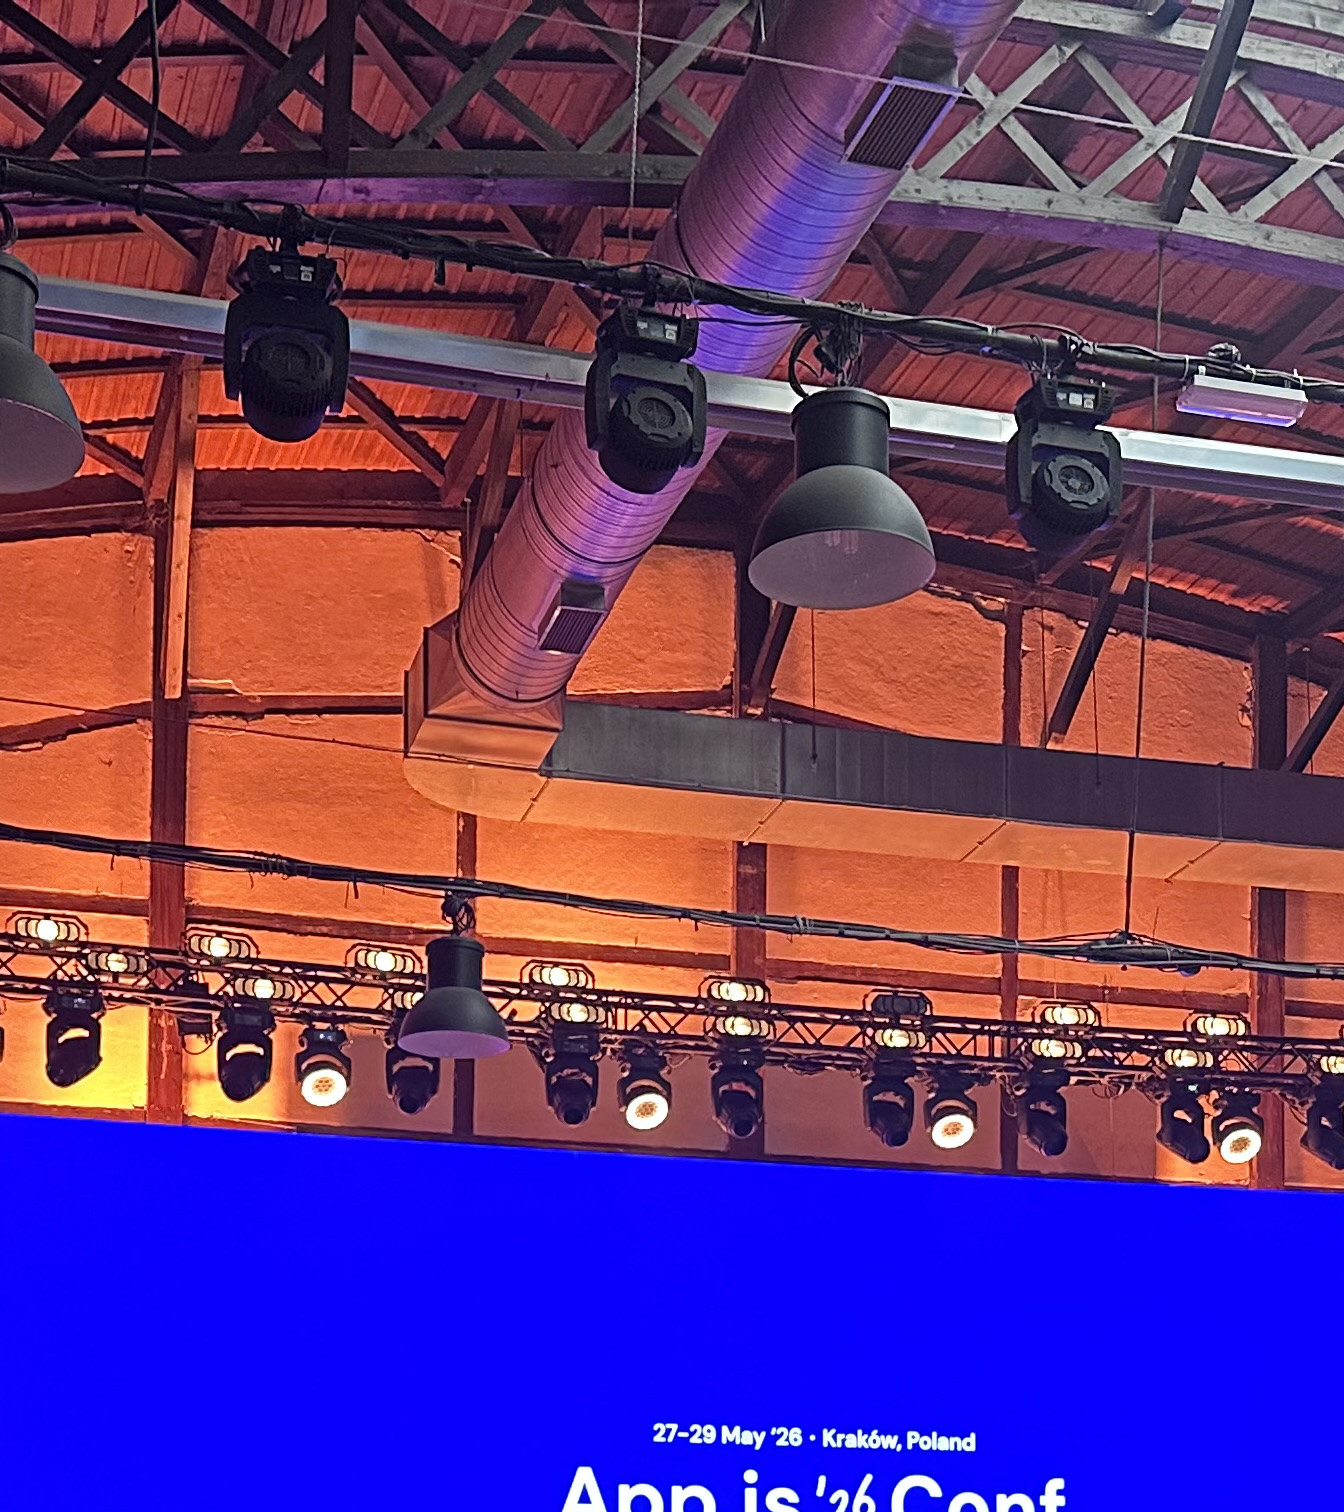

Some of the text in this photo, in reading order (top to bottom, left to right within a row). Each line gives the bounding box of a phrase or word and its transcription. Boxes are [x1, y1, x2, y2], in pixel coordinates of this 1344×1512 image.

[721, 1425, 766, 1450] May
[823, 1428, 902, 1452] Kraków,
[907, 1431, 976, 1451] Poland
